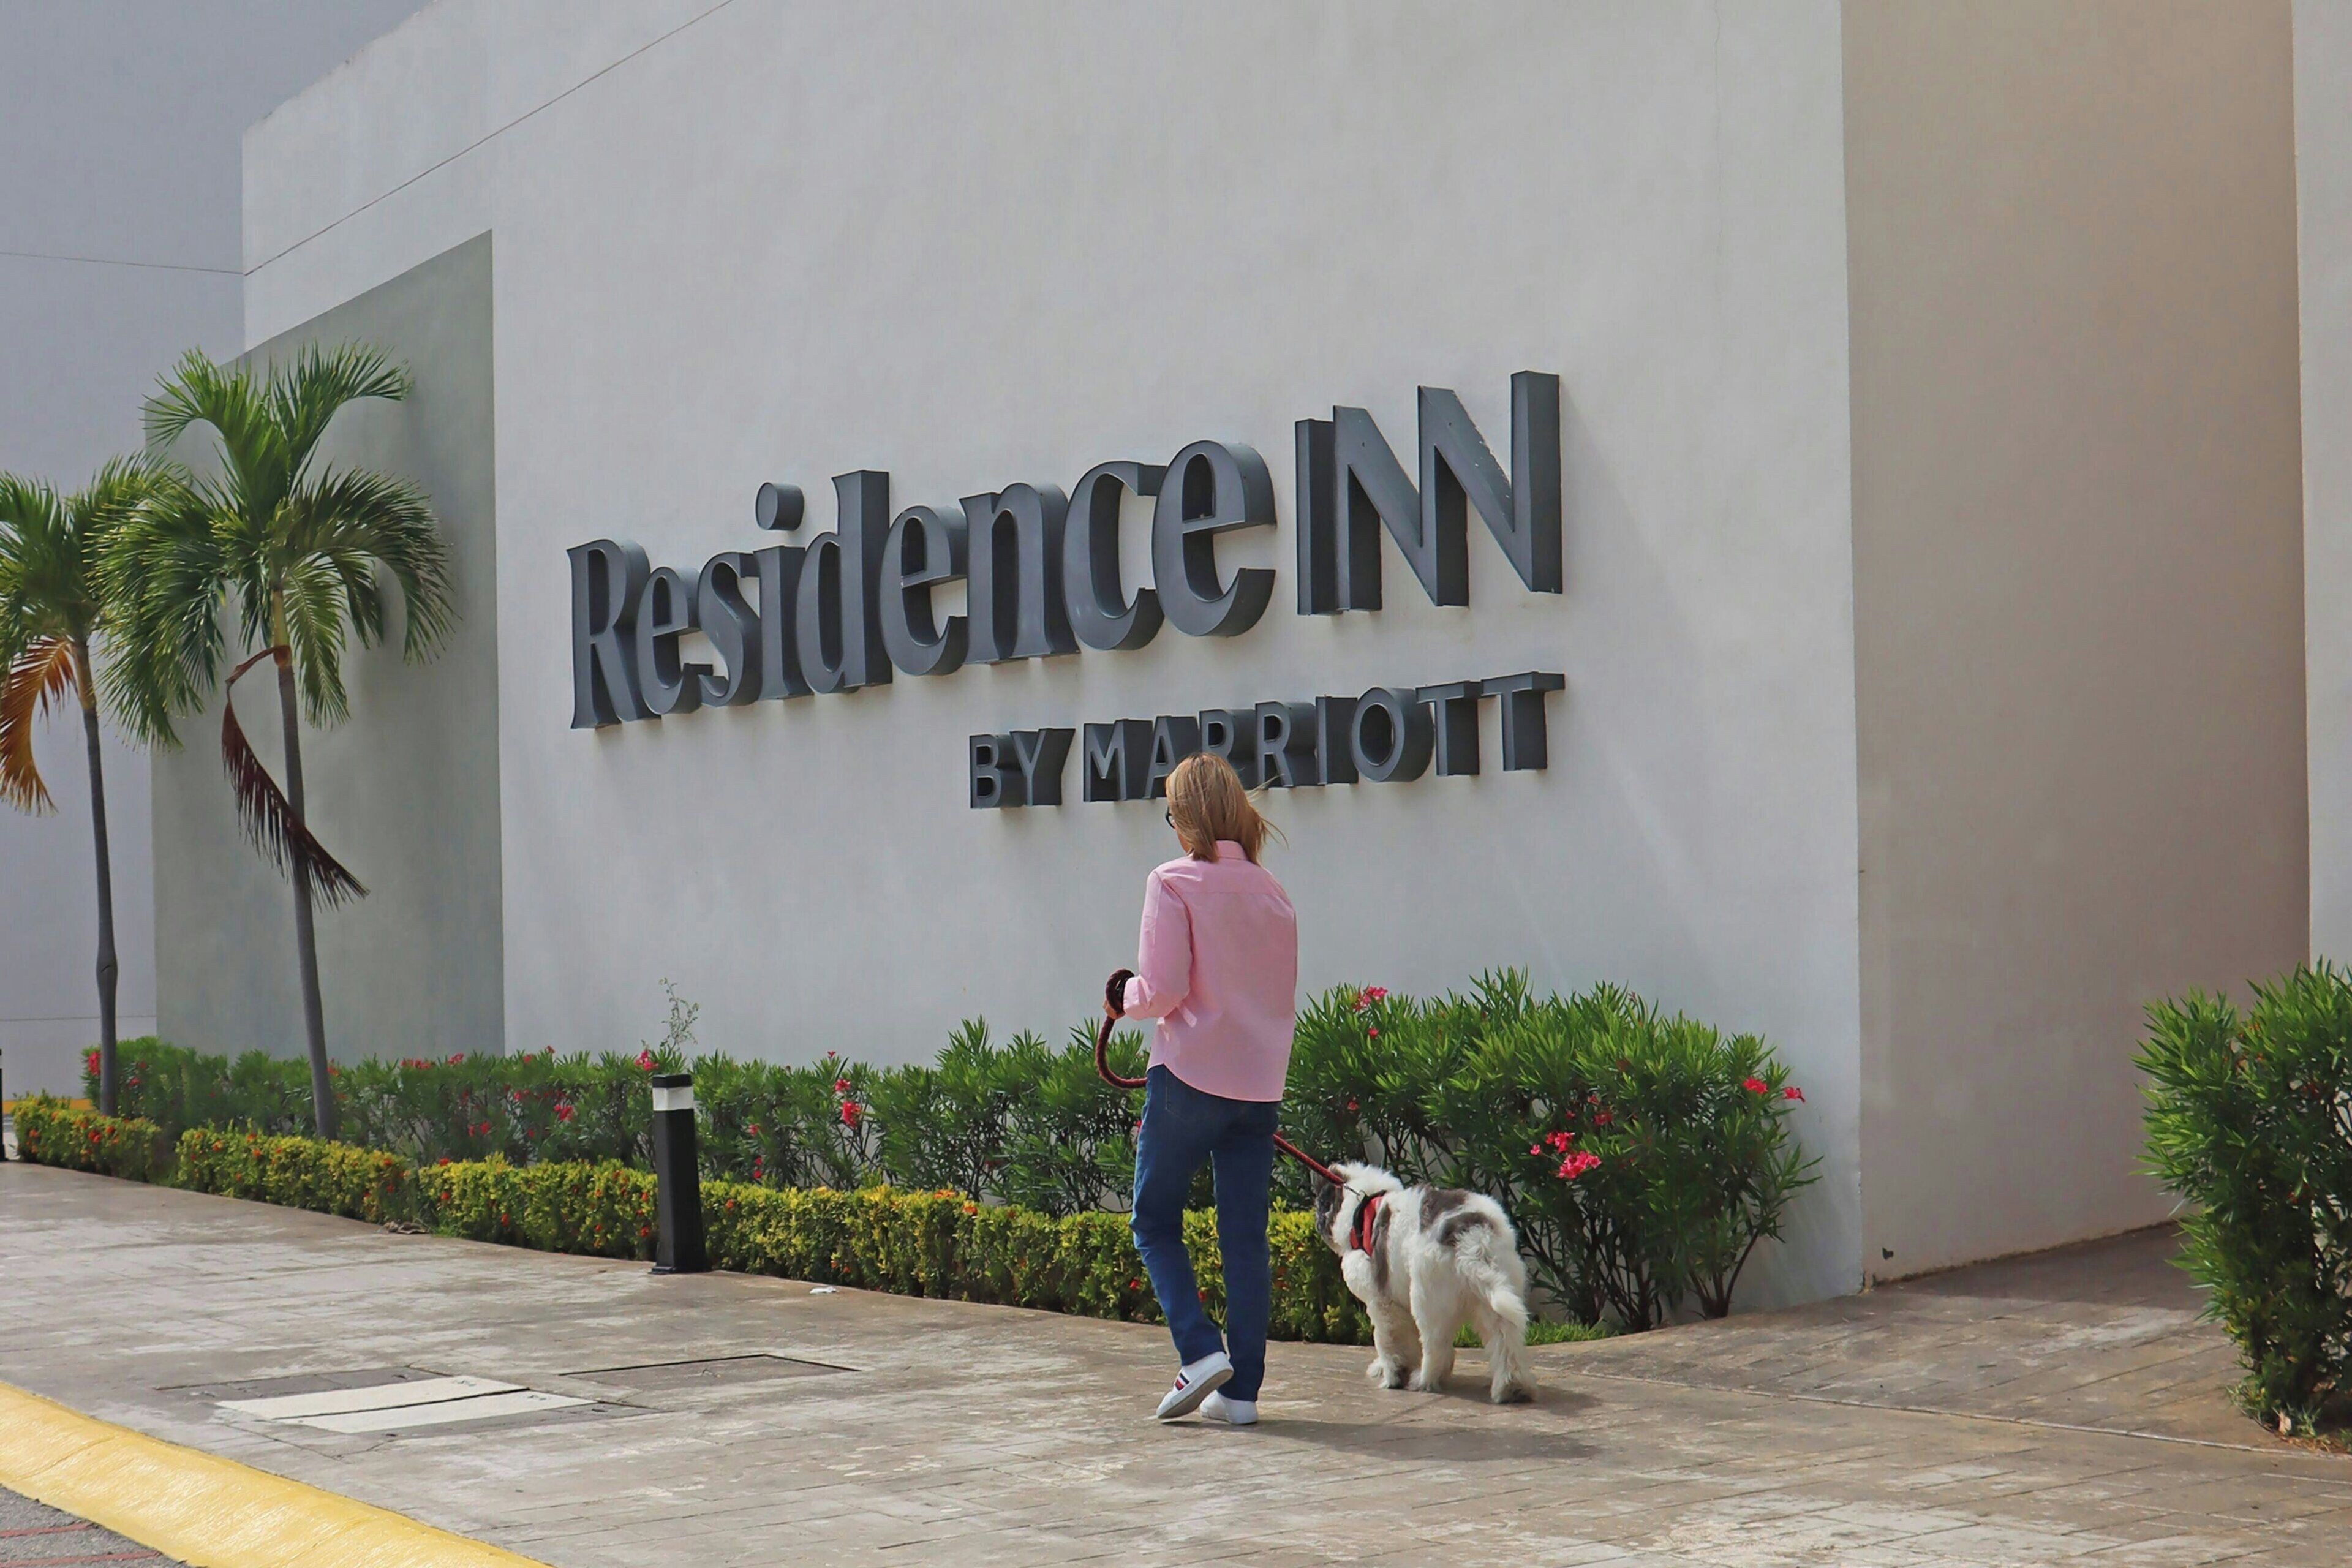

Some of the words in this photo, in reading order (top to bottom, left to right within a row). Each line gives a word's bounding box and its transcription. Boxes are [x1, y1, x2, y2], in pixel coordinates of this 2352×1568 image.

[567, 440, 1276, 730] Residence
[1295, 370, 1563, 616] INN
[970, 727, 1076, 809] BY
